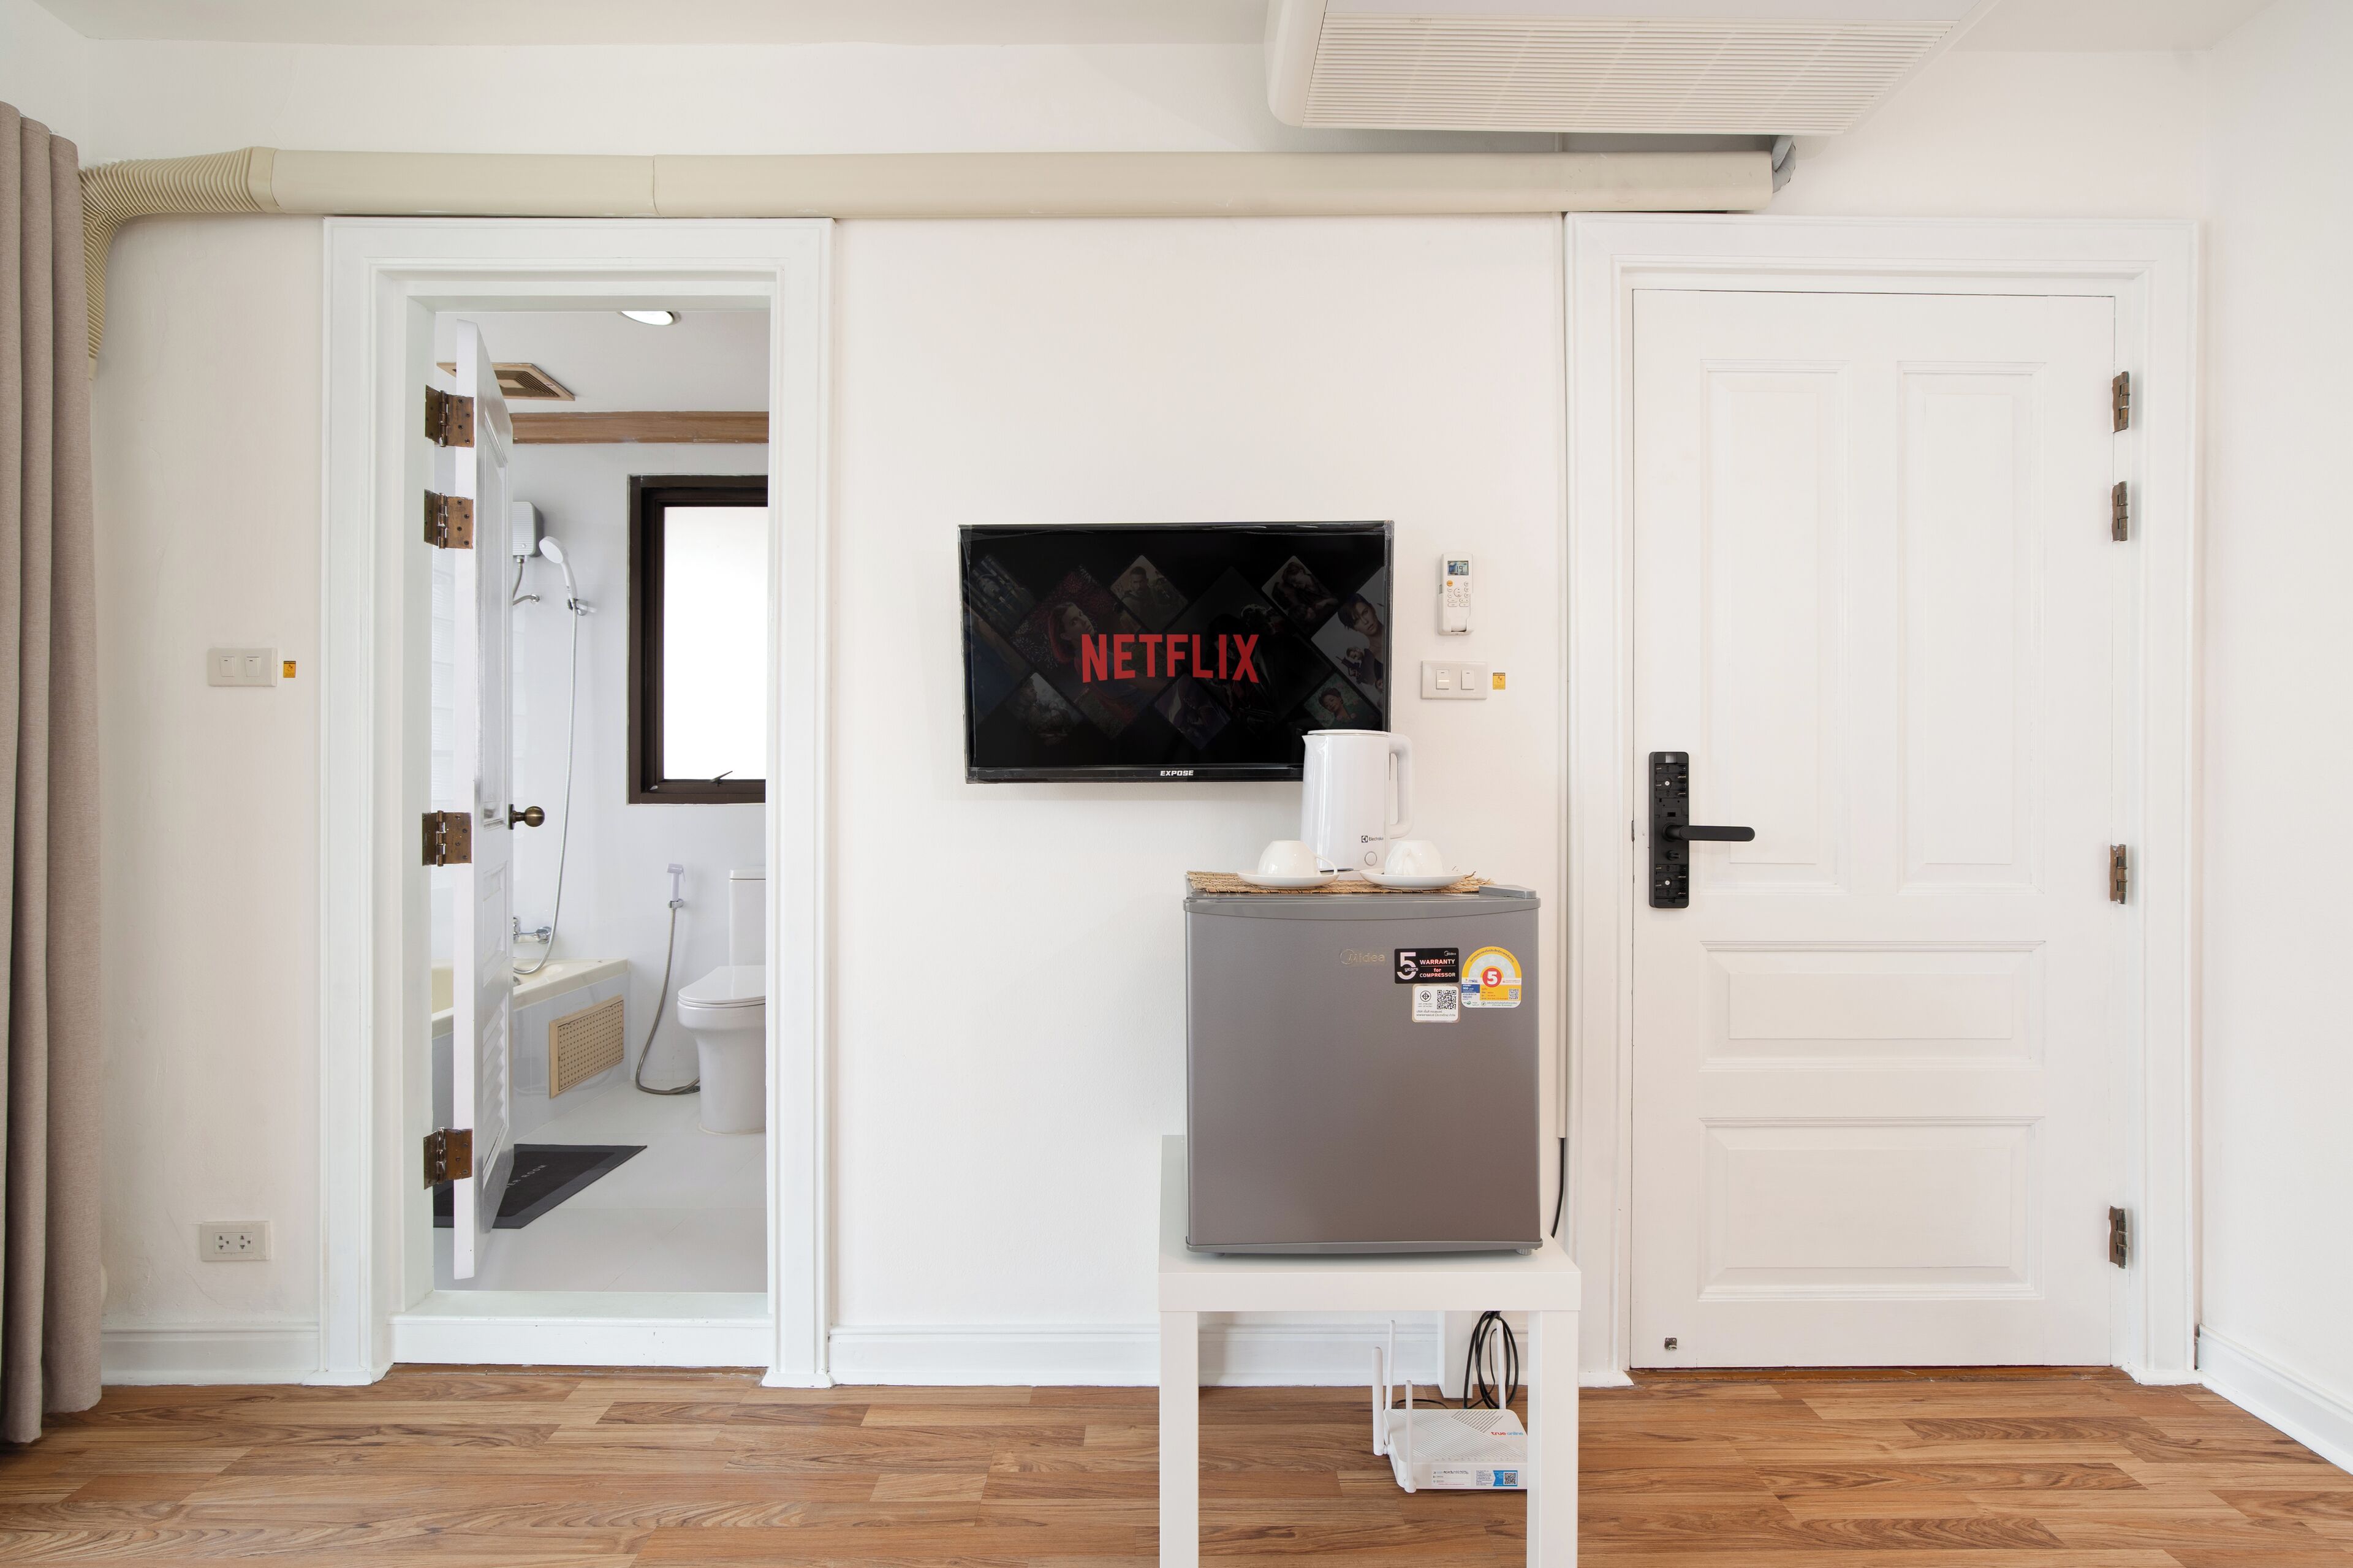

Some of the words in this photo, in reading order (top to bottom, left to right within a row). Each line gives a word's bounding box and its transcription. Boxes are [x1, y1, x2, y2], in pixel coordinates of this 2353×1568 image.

[1081, 634, 1260, 683] NETFLIX
[1340, 949, 1385, 964] Midea
[1397, 952, 1416, 980] 5
[1487, 971, 1498, 985] 5
[521, 1165, 547, 1178] ROOM
